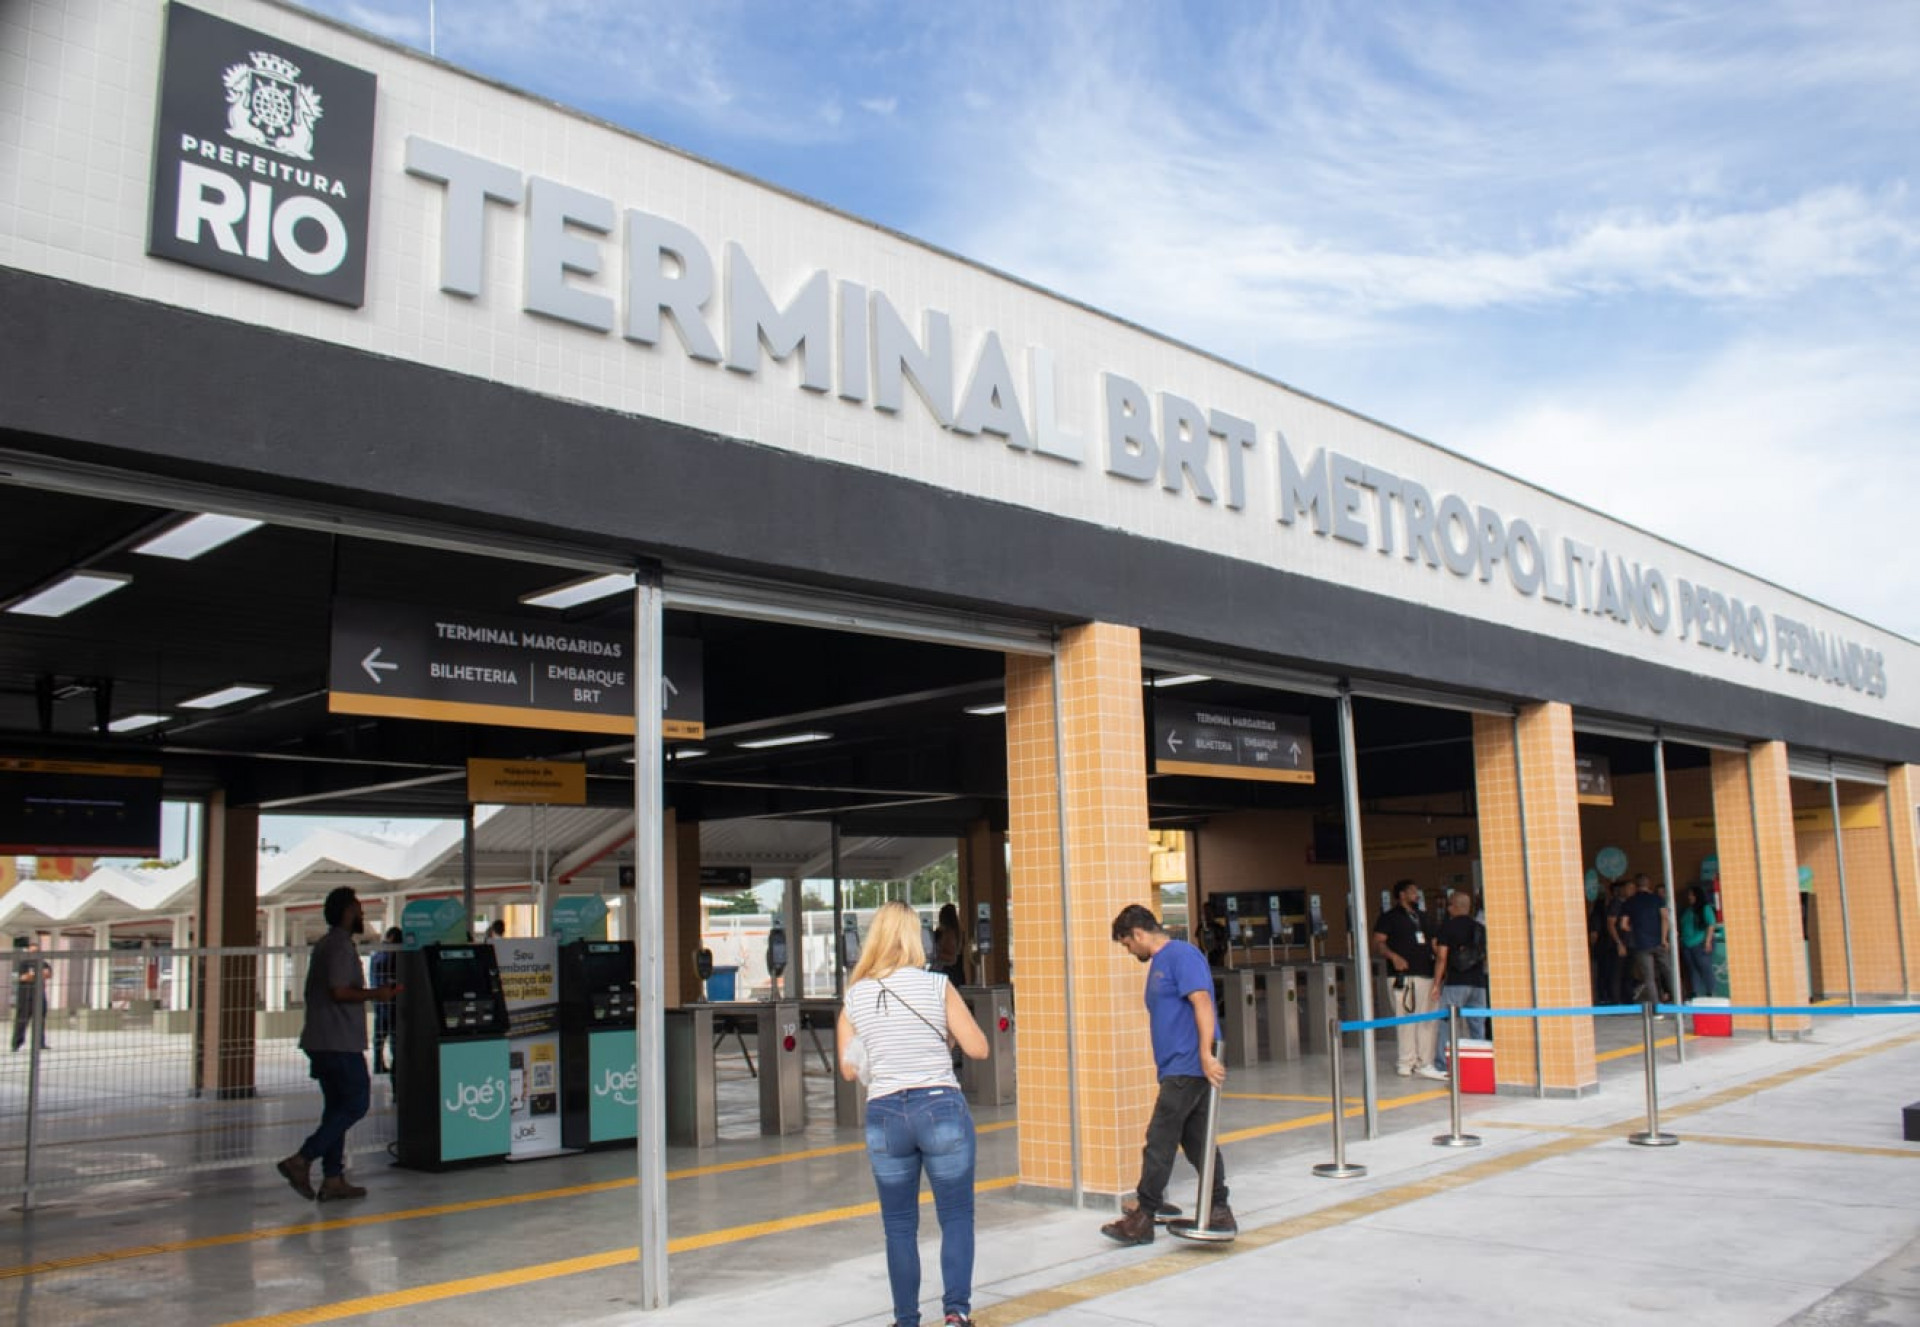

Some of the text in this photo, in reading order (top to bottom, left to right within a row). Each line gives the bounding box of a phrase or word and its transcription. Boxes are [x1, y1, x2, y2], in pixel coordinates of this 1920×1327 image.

[181, 134, 348, 199] PREFEITURA
[175, 160, 349, 276] RIO
[404, 134, 1887, 699] TERMINAL BRT METROPOLITANO PEDRO FERNANDES
[435, 621, 623, 658] TERMINAL MARGARIDAS
[430, 662, 518, 685] BILHETERIA
[548, 665, 626, 688] EMBARQUE
[573, 687, 602, 704] BRT
[1196, 712, 1276, 731] TERMINAL MARGARIDAS
[1196, 738, 1232, 751] BILHETERIA
[1244, 737, 1278, 750] EMBARQUE
[514, 950, 534, 960] Seu
[594, 1064, 637, 1095] Jaé
[446, 1076, 495, 1112] Jaé
[514, 1122, 537, 1140] Jaé
